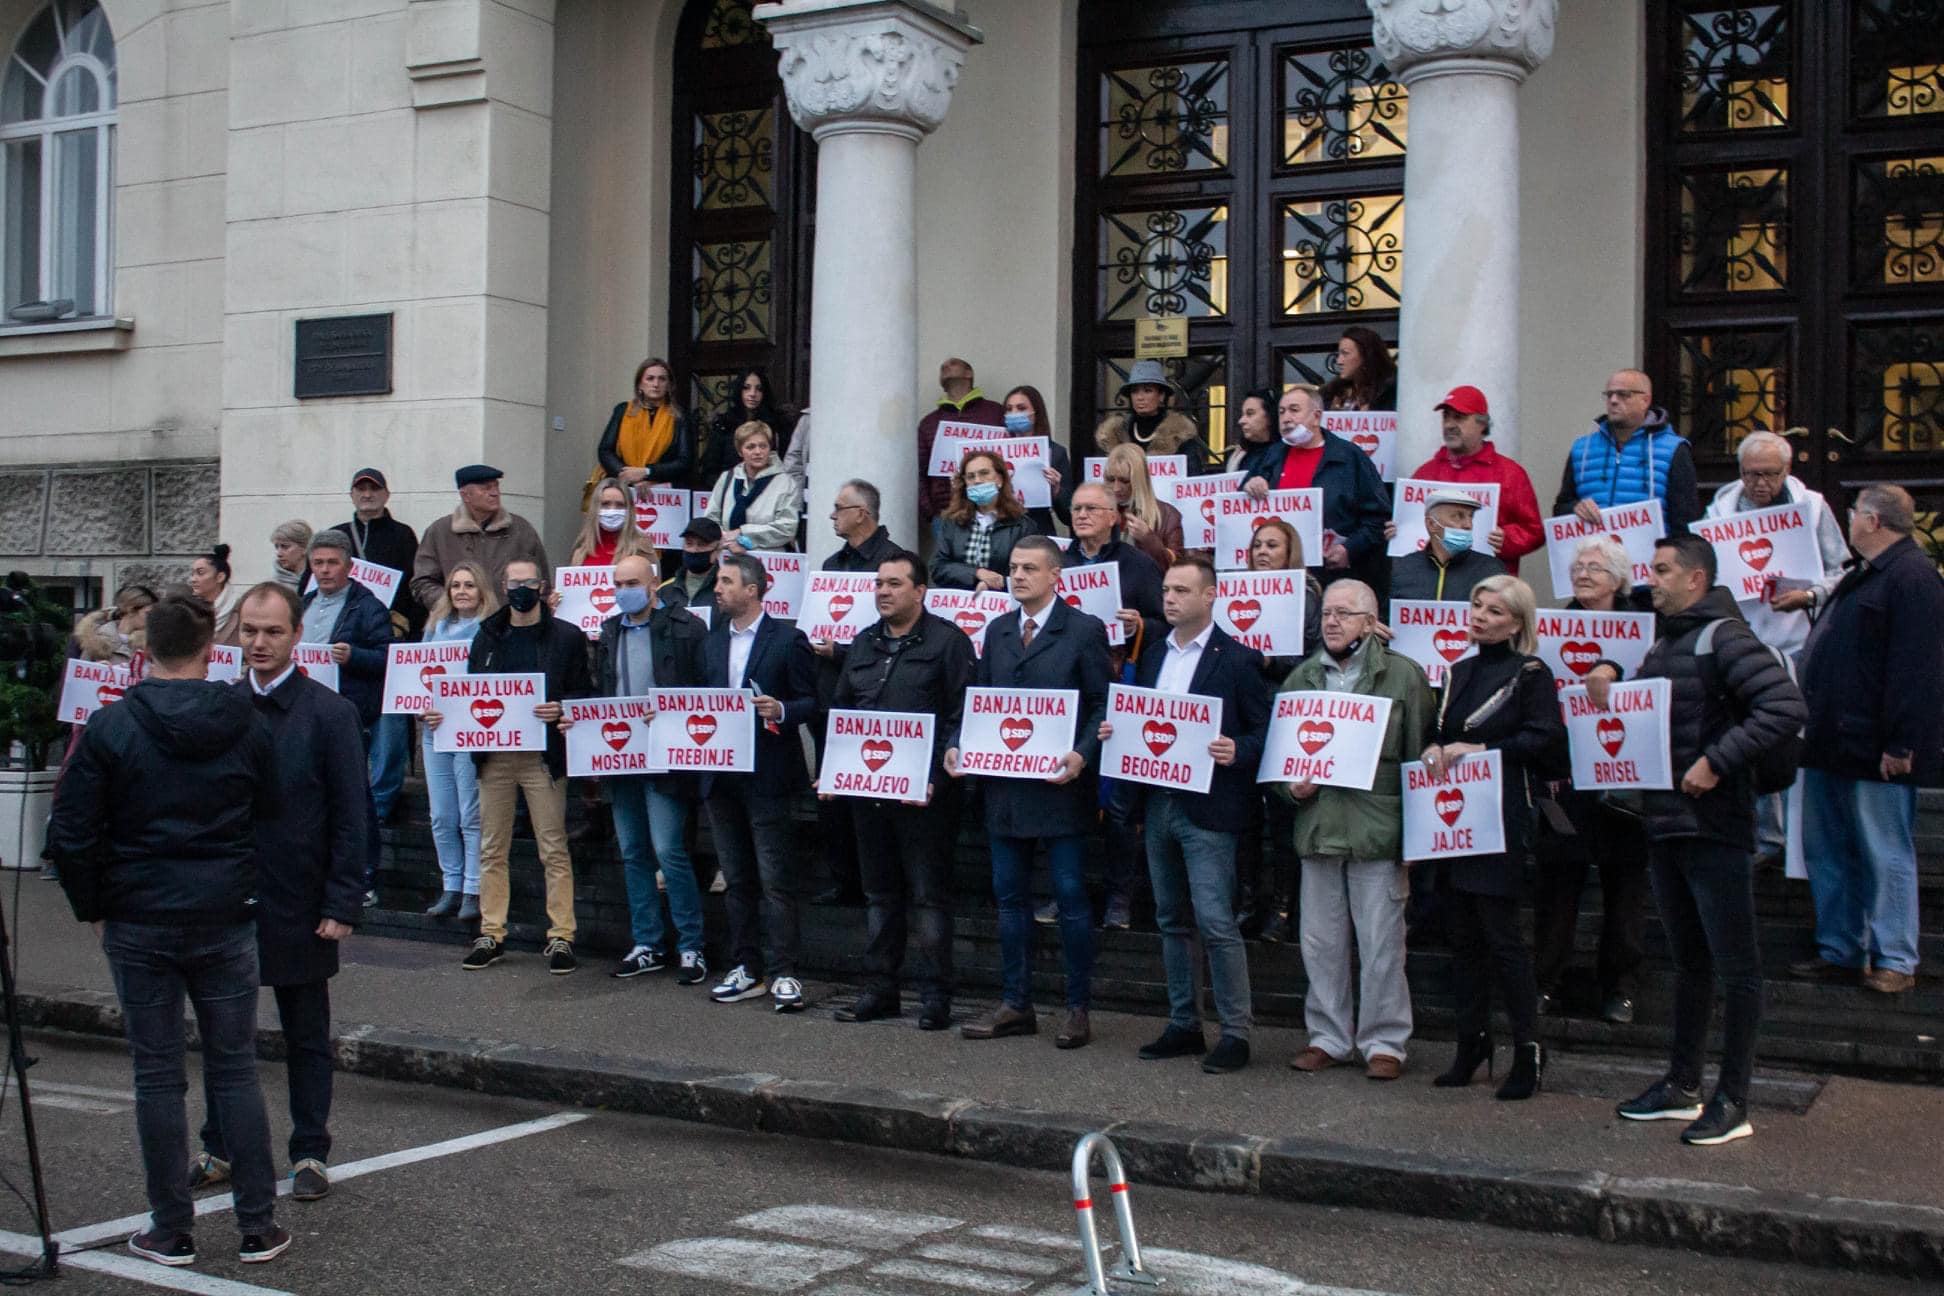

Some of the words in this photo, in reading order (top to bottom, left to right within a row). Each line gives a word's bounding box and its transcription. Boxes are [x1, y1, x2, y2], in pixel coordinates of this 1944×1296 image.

[943, 425, 983, 439] BANJA
[1326, 416, 1370, 432] BANJA
[1372, 416, 1397, 432] LUK
[1007, 442, 1040, 459] LUKA
[1149, 461, 1178, 476] UKA
[1175, 480, 1217, 500] BANJA
[1219, 479, 1239, 493] LUK
[1222, 497, 1271, 515] BANJA
[1275, 495, 1312, 513] LUKA
[1610, 508, 1652, 530] LUKA
[1700, 519, 1756, 544] BANJA
[1758, 510, 1804, 535] LUKA
[767, 557, 800, 573] LUKA
[361, 569, 392, 587] LUKA
[563, 571, 609, 587] BANJA
[810, 577, 849, 593] BANJA
[1069, 570, 1110, 591] LUKA
[1216, 579, 1249, 598] NJA
[1252, 576, 1294, 596] LUKA
[930, 594, 977, 609] BANJA
[980, 595, 1013, 612] LUK
[1400, 606, 1457, 626] BANJA
[810, 623, 857, 640] ANKARA
[1537, 617, 1586, 638] ANJA
[1592, 619, 1641, 640] LUKA
[209, 649, 233, 665] UKA
[303, 649, 331, 665] LUKA
[395, 648, 437, 665] BANJA
[439, 645, 470, 663] LUKA
[1575, 652, 1599, 663] SDP
[74, 664, 117, 686] BANJA
[440, 680, 491, 697] BANJA
[495, 679, 535, 696] LUKA
[394, 695, 433, 710] PODG
[657, 694, 705, 711] BANJA
[708, 694, 745, 712] LUKA
[972, 694, 1022, 715] BANJA
[1026, 696, 1066, 716] LUKA
[1115, 692, 1165, 718] BANJA
[1170, 699, 1211, 725] LUKA
[1615, 688, 1654, 713] LUKA
[571, 703, 617, 721] BANJA
[1277, 698, 1324, 719] BANJA
[1328, 699, 1375, 723] LUKA
[835, 716, 882, 737] BANJA
[886, 719, 924, 739] LUKA
[1011, 728, 1033, 738] SDP
[456, 730, 522, 747] SKOPLJE
[1154, 731, 1176, 744] SDP
[1308, 732, 1332, 743] SDP
[591, 752, 647, 771] MOSTAR
[667, 748, 734, 766] TREBINJE
[962, 751, 1060, 773] SREBRENICA
[1121, 754, 1192, 784] BEOGRAD
[1283, 755, 1335, 779] BIHAĆ
[1455, 759, 1492, 784] LUKA
[1594, 760, 1640, 783] BRISEL
[834, 772, 910, 795] SARAJEVO
[1431, 828, 1473, 852] JAJCE
